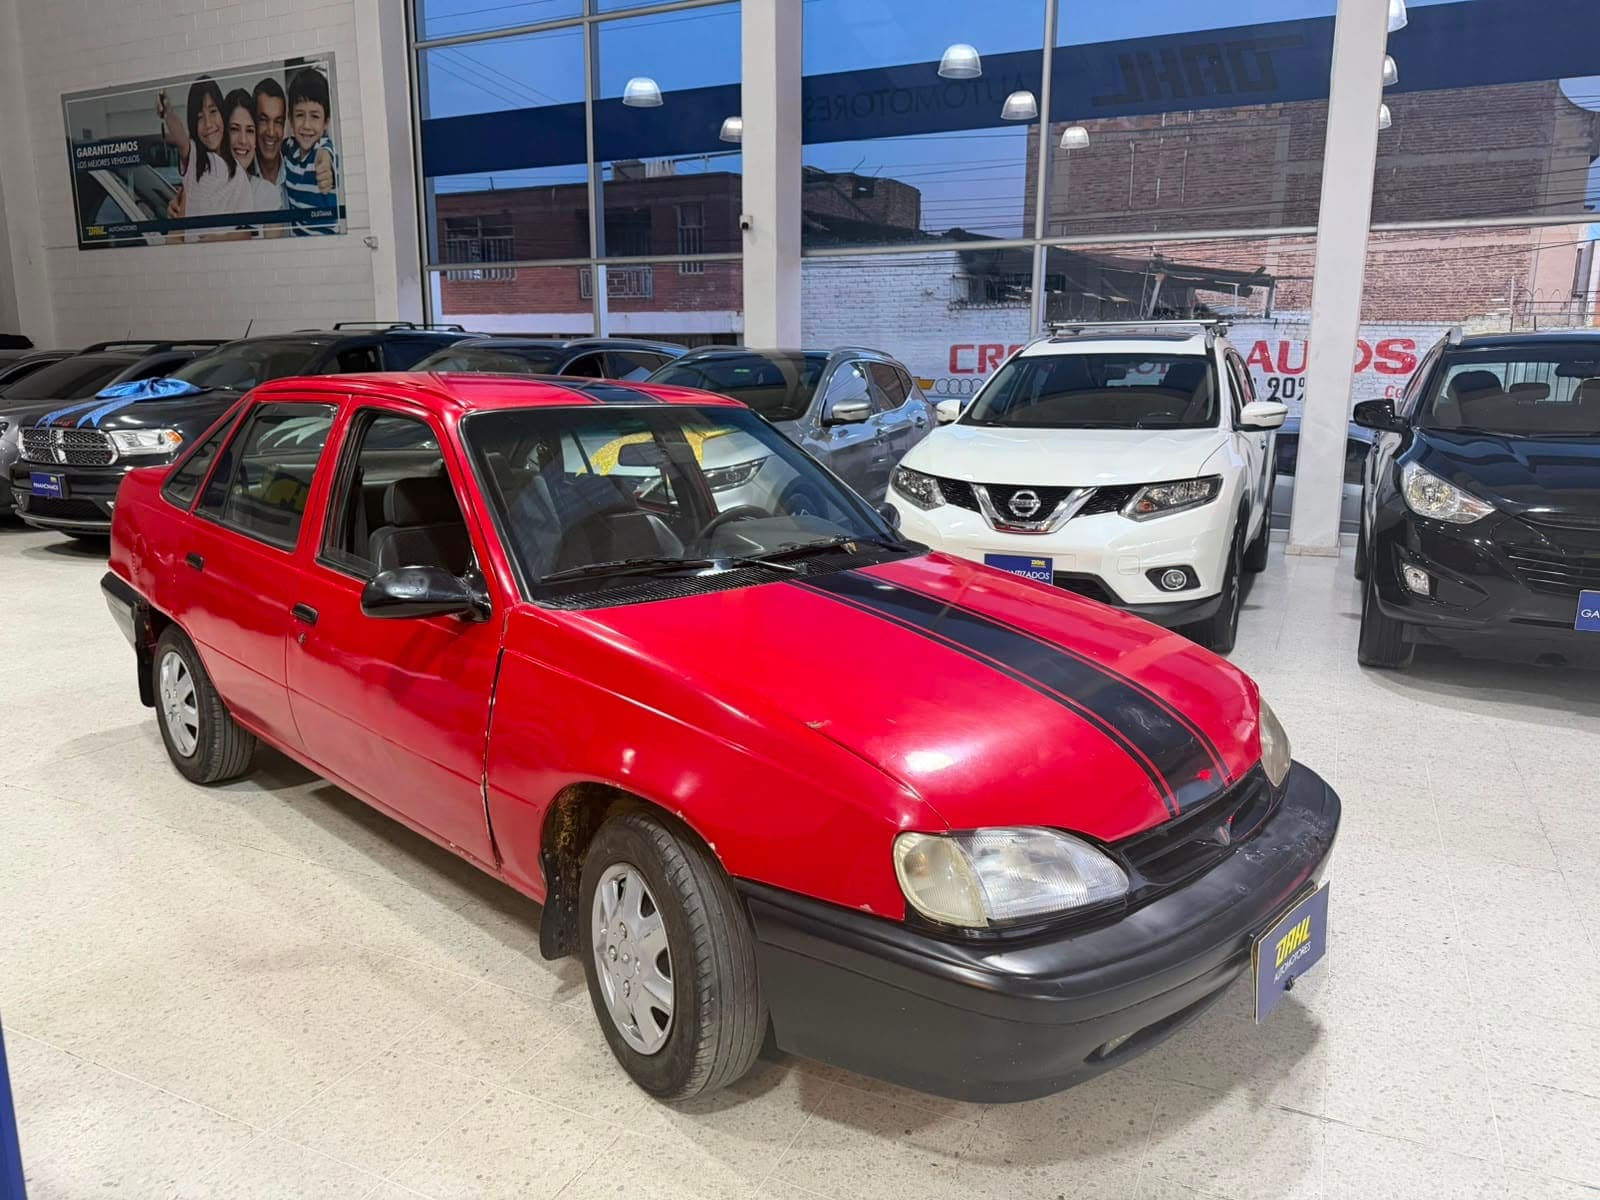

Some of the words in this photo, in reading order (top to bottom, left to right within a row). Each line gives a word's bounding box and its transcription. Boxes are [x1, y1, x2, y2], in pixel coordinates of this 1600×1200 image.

[77, 141, 138, 157] GARANTIZAMOS
[77, 160, 88, 169] LOS
[1275, 915, 1311, 968] DAHL
[1273, 940, 1312, 984] AUTOMOTORES
